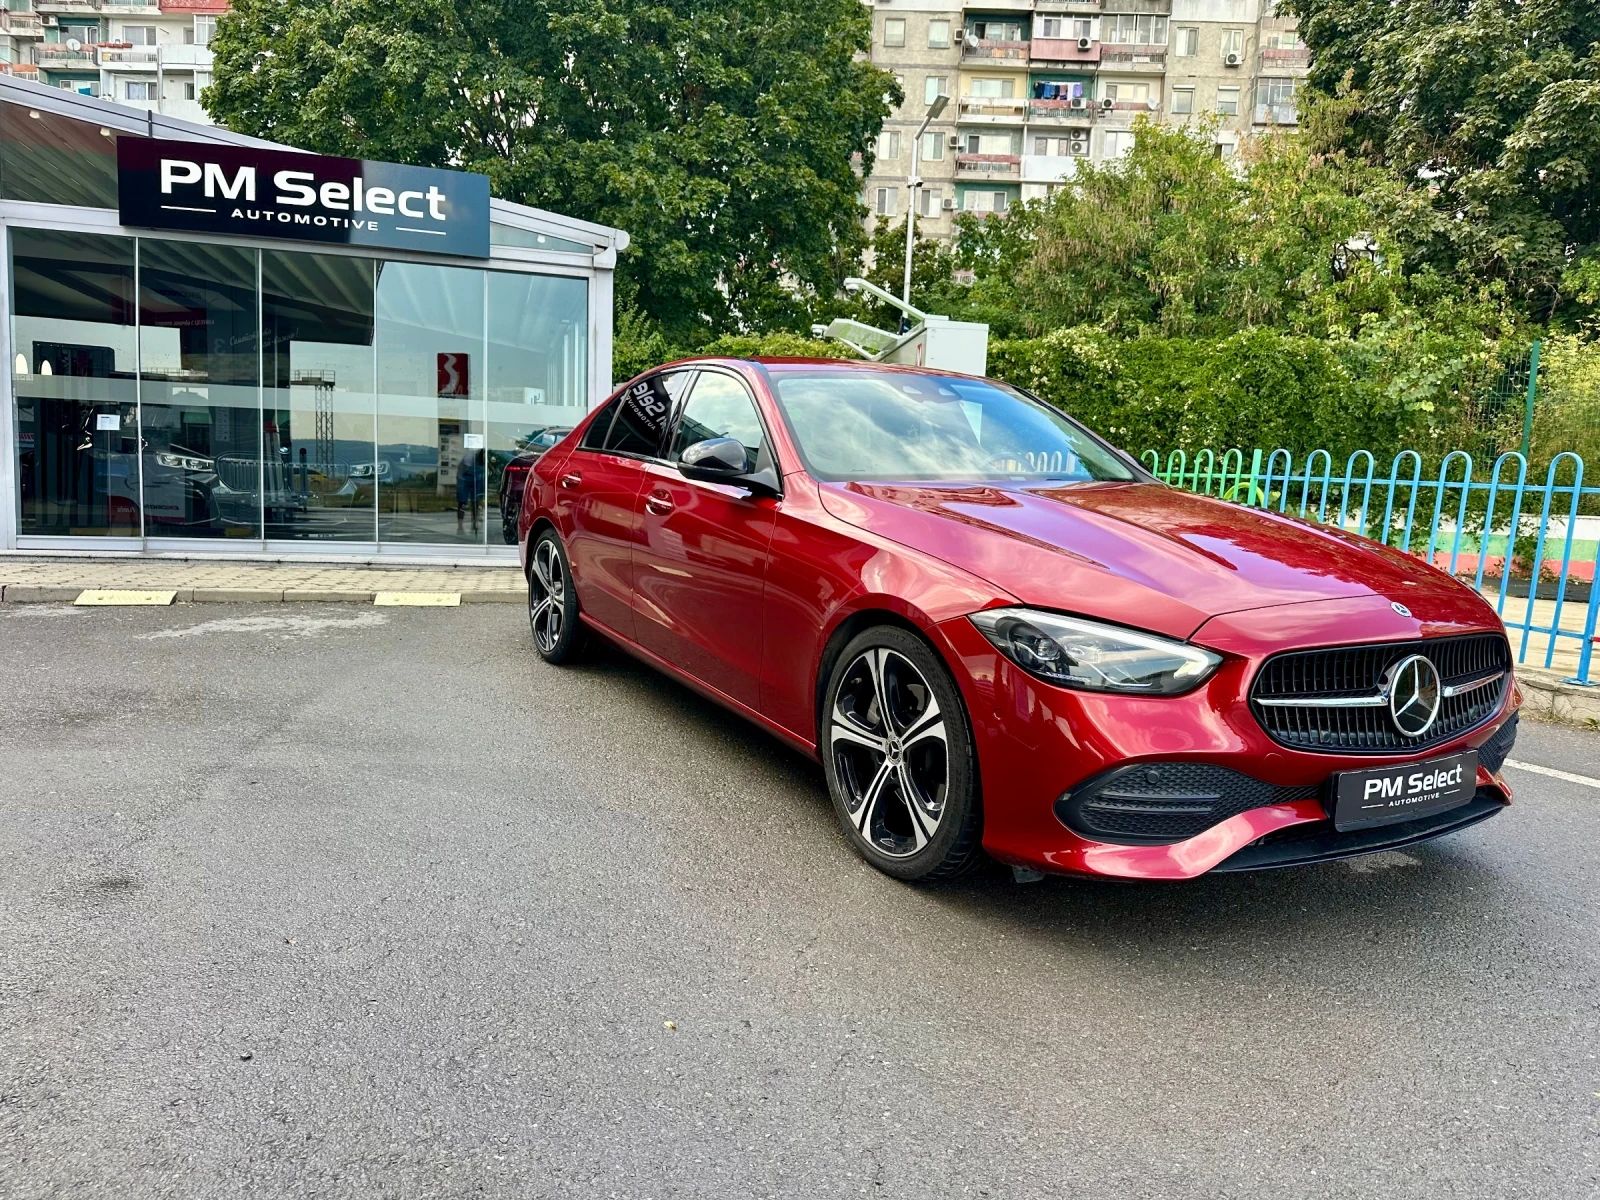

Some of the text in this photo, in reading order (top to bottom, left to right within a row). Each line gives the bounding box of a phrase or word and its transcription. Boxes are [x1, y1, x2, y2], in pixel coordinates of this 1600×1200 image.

[160, 158, 446, 221] PM Select
[231, 208, 379, 231] AUTOMOTIVE
[1363, 763, 1463, 801] PM Select
[1388, 792, 1440, 807] AUTOMOTIVE
